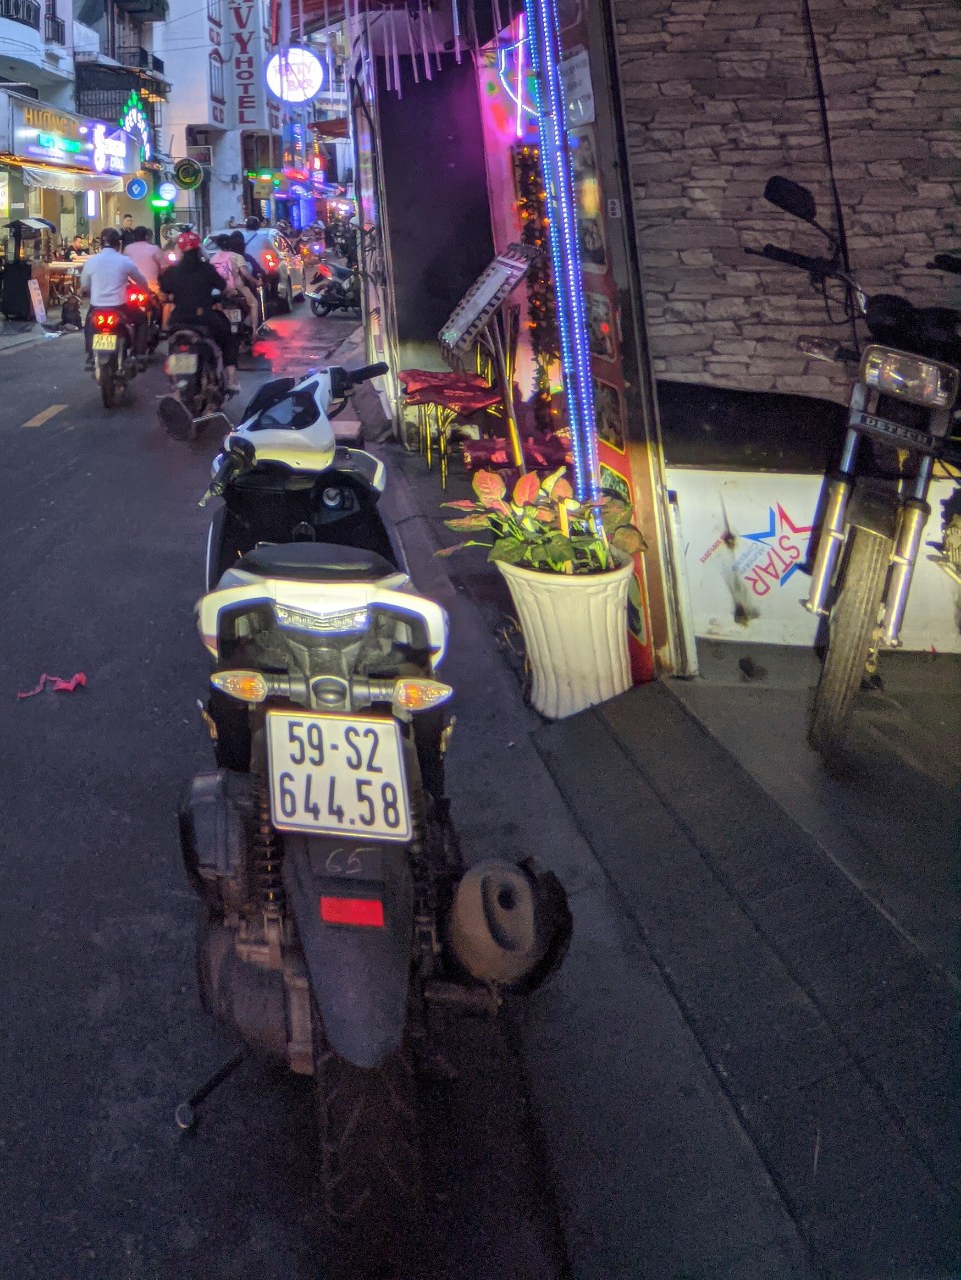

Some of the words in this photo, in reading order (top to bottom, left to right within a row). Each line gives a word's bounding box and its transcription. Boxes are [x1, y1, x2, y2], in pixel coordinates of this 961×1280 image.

[234, 56, 256, 124] HOTEL
[744, 535, 800, 596] STAR
[287, 720, 384, 774] 59-S2
[279, 771, 401, 829] 644.58
